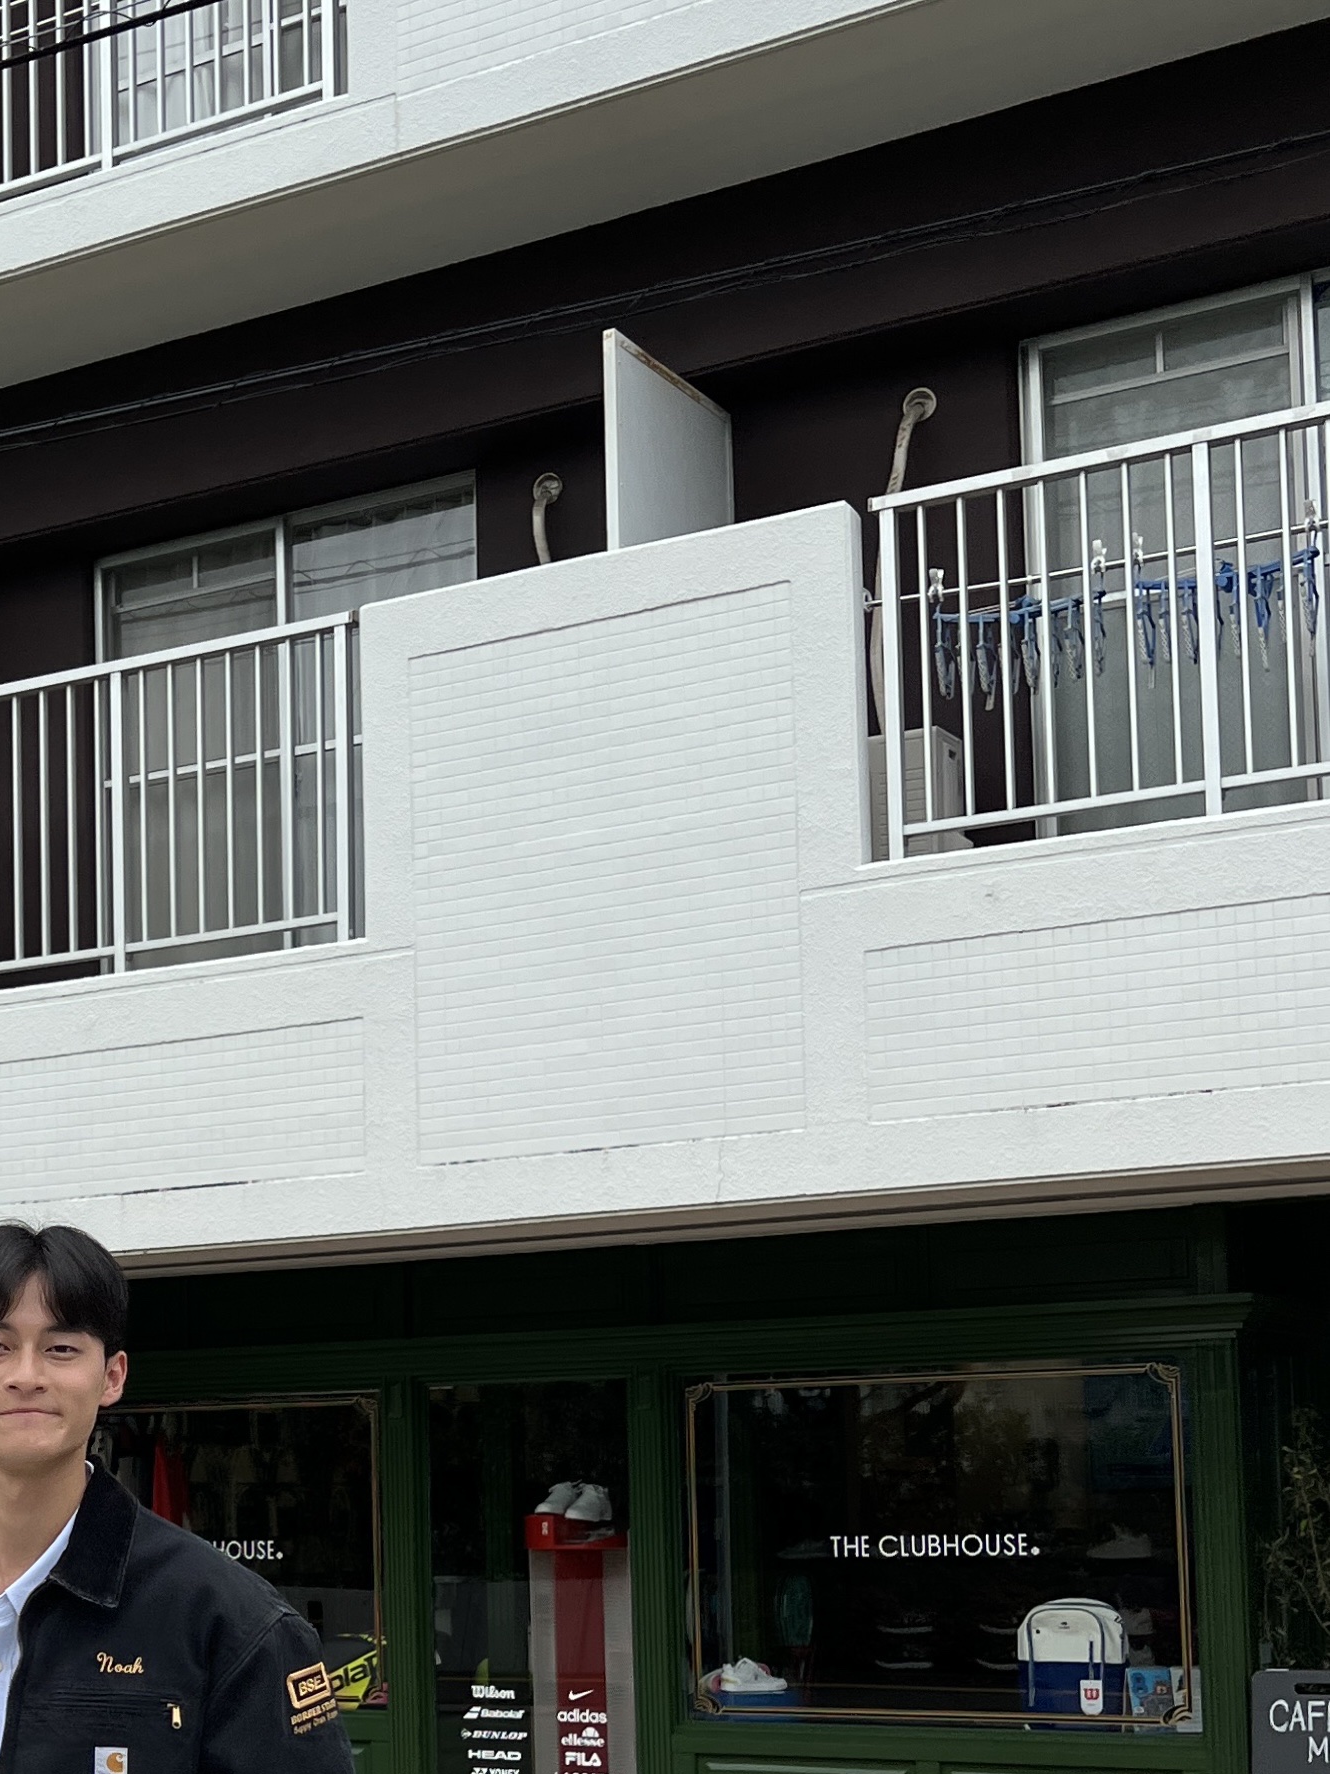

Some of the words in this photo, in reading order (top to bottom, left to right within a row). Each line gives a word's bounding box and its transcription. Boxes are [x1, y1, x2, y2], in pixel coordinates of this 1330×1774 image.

[830, 1535, 870, 1558] THE
[878, 1533, 1040, 1557] CLUBHOUSE.
[96, 1651, 145, 1674] Noah
[298, 1675, 326, 1697] BSE
[471, 1684, 516, 1700] Wilson
[556, 1708, 608, 1724] adidas
[472, 1729, 528, 1741] DUNLOP
[560, 1733, 606, 1748] ellesse
[467, 1748, 522, 1761] HEAD
[564, 1751, 602, 1767] FILA
